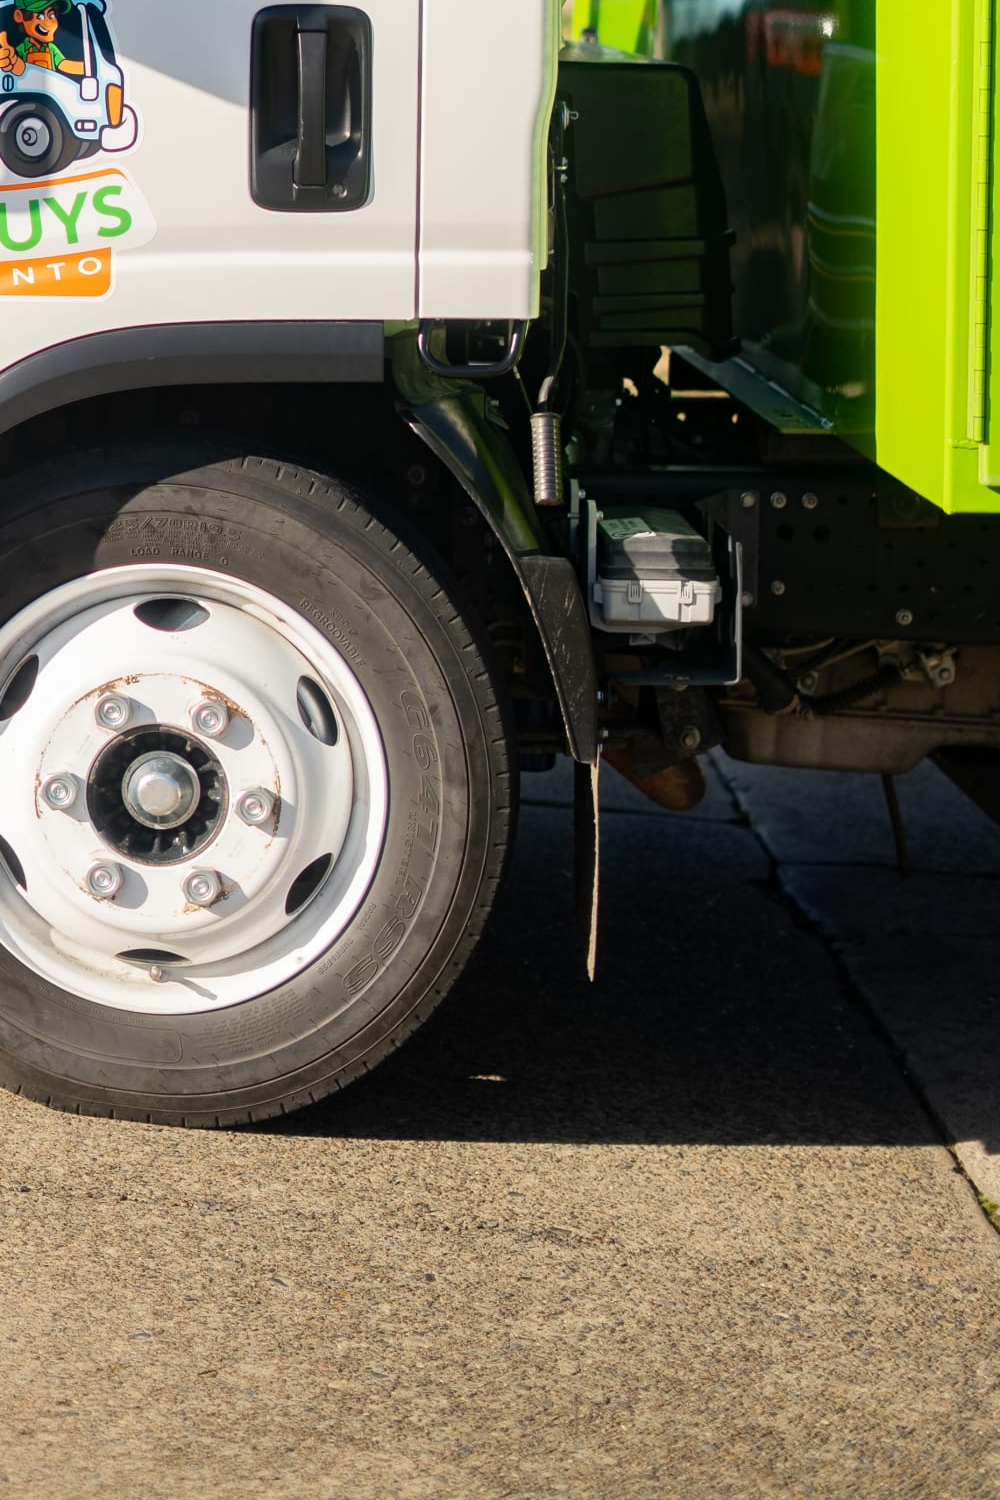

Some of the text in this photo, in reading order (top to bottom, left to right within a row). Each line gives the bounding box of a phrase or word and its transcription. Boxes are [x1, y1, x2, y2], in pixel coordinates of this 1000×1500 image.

[130, 547, 161, 557] LOAD
[171, 547, 210, 562] RANGE
[299, 598, 367, 667] REGROOVABLE
